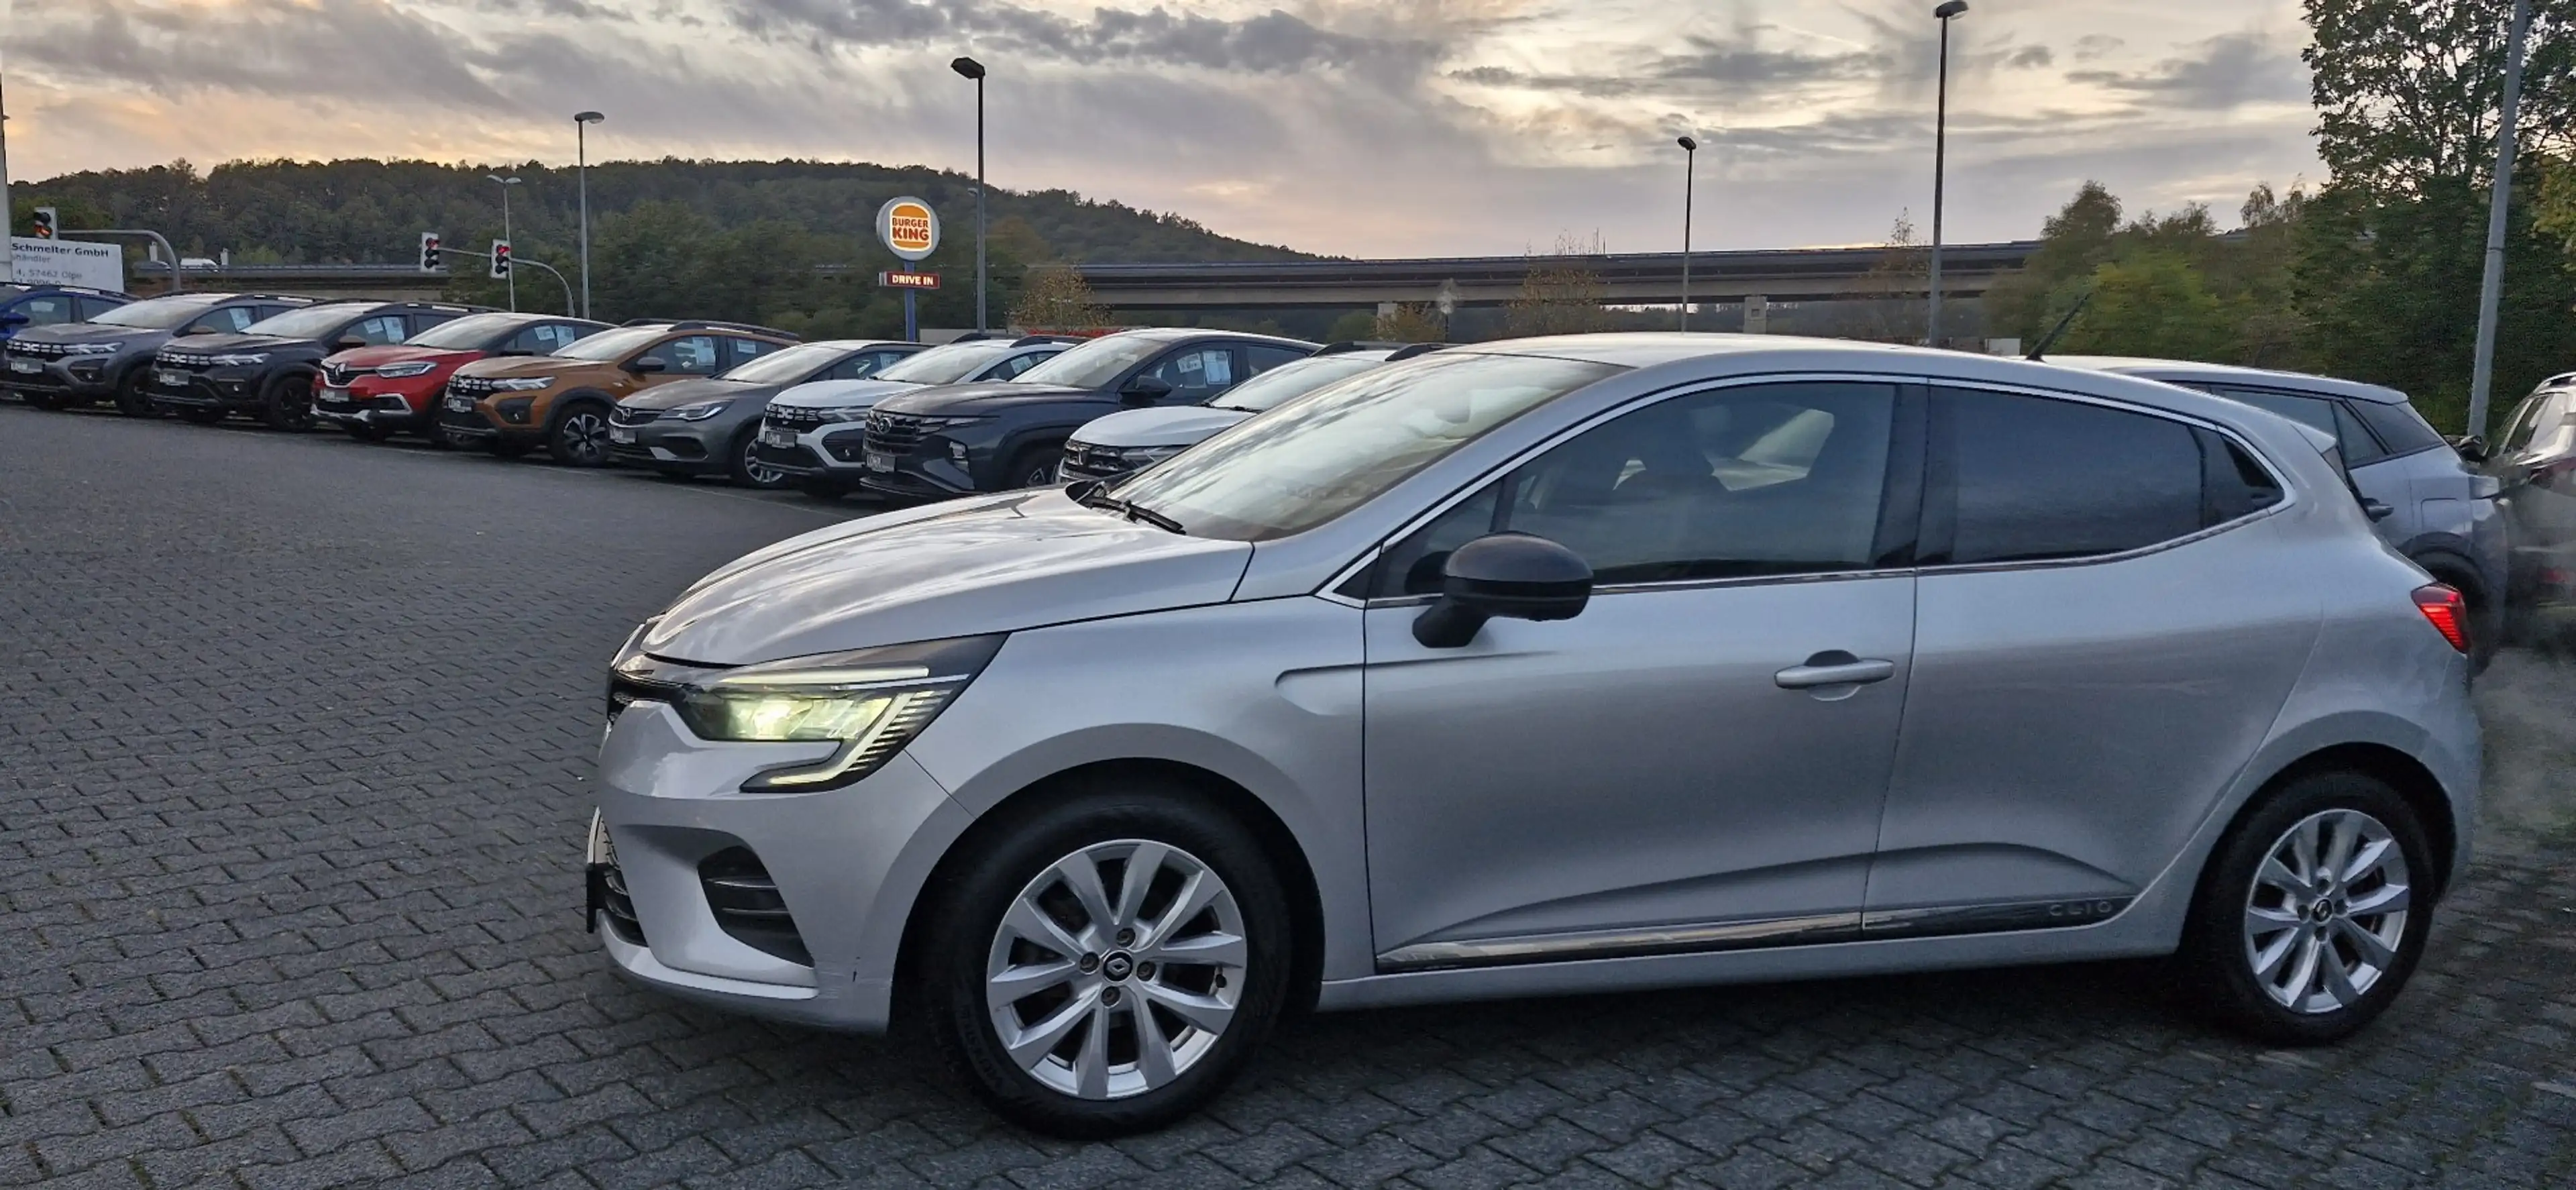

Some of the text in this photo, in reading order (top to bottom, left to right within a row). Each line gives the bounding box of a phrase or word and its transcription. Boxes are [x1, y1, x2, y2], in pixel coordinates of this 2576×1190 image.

[892, 217, 928, 228] BURGER
[892, 227, 929, 241] KING
[11, 243, 109, 258] Schmelter GmbH
[892, 274, 934, 286] DRIVE IN
[2050, 901, 2112, 916] CLIO
